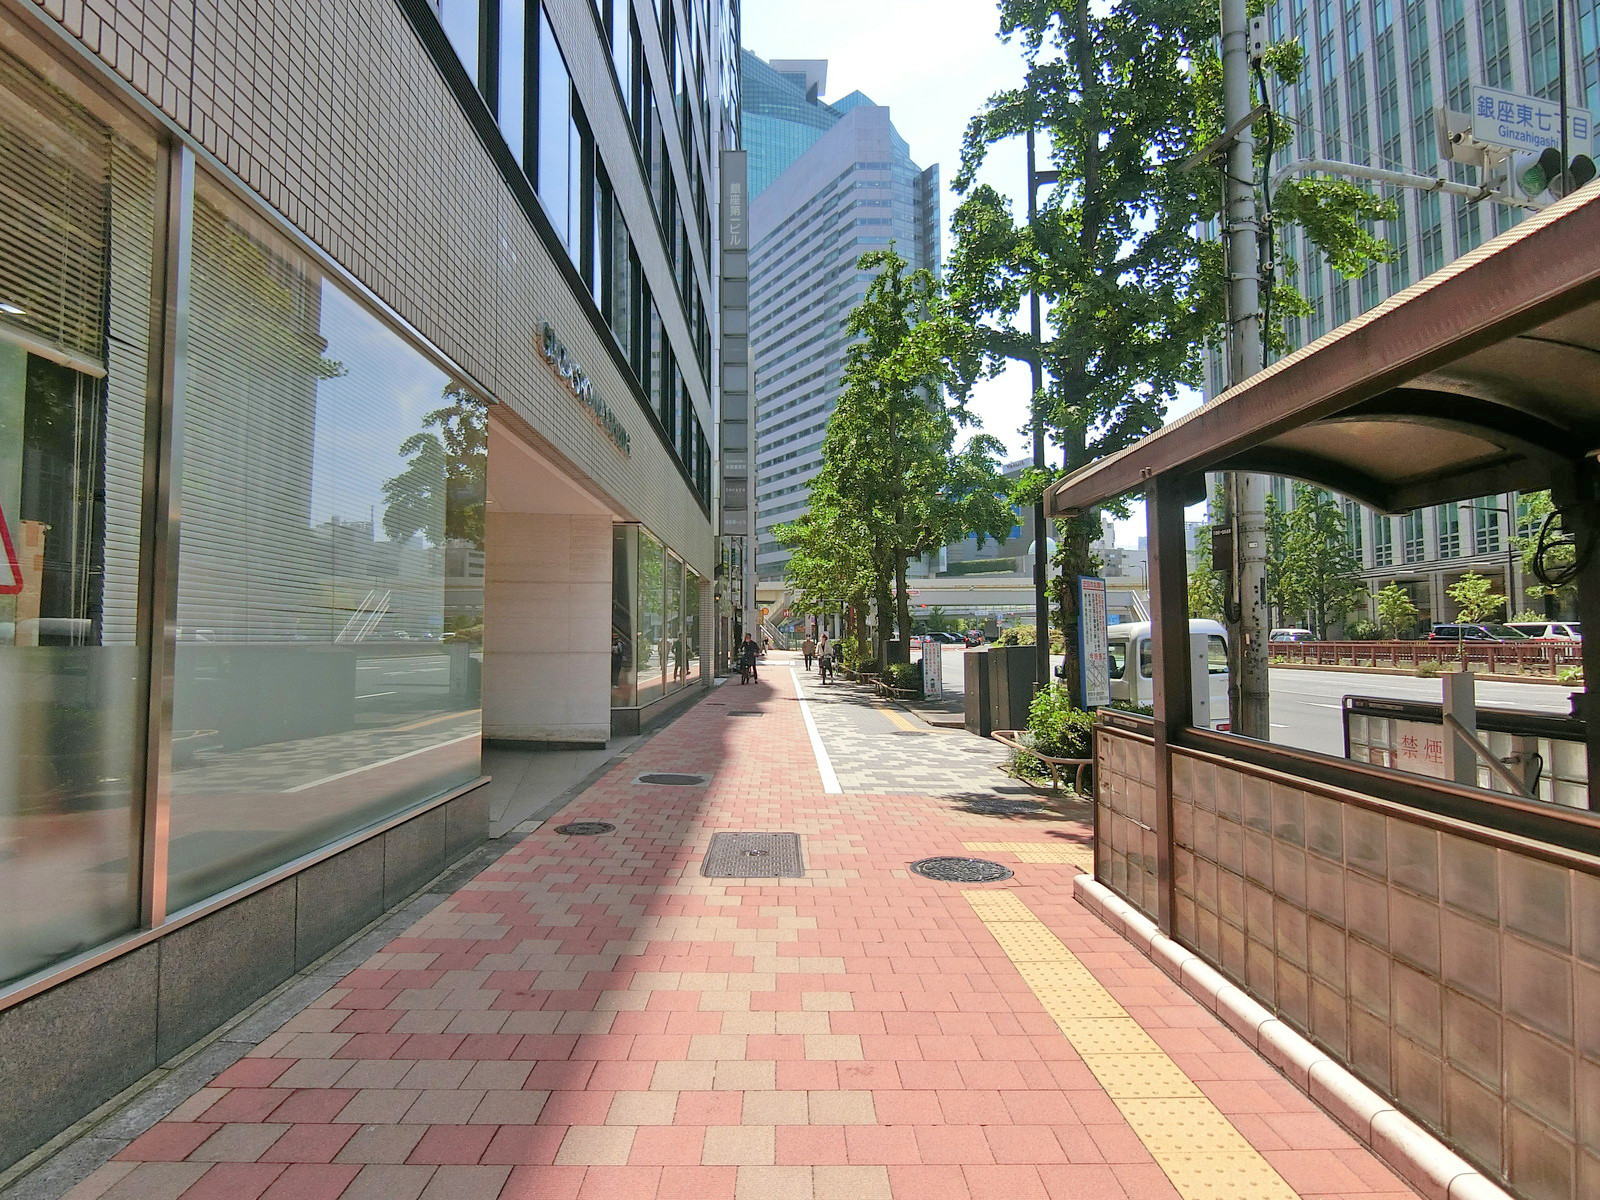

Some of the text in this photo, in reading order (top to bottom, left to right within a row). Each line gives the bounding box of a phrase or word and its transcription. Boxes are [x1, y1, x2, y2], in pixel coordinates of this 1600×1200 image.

[1498, 125, 1560, 149] Ginzahigashi
[729, 183, 741, 246] 銀座第一ビル
[1401, 734, 1444, 765] 禁煙
